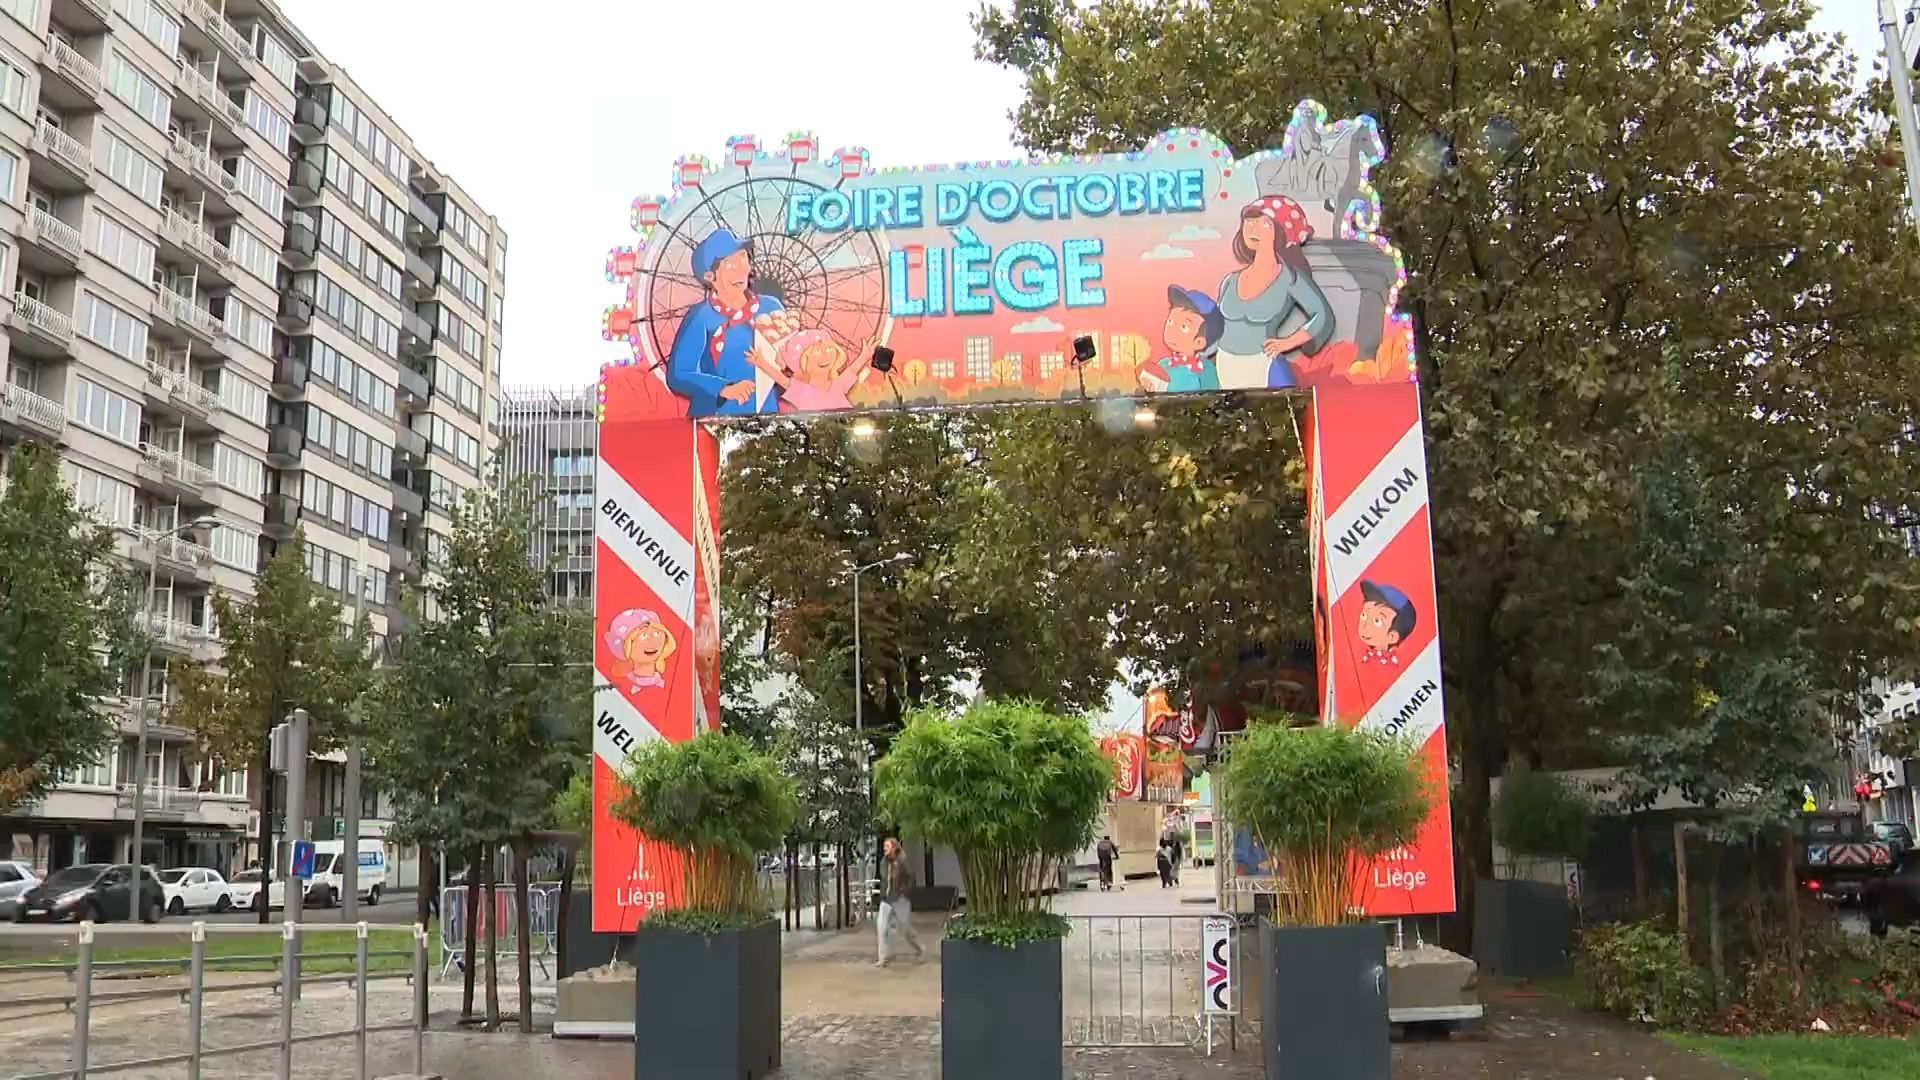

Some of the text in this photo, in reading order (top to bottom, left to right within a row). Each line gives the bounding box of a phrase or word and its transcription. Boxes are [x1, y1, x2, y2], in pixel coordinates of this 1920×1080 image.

[786, 168, 1206, 237] FOIRE D'OCTOBRE
[889, 224, 1106, 317] LIÈGE
[601, 498, 690, 587] BIENVENUE
[1333, 467, 1419, 556] WELKOM
[1376, 680, 1438, 744] OMMEN
[617, 886, 664, 910] Liège
[1374, 867, 1426, 890] Liège
